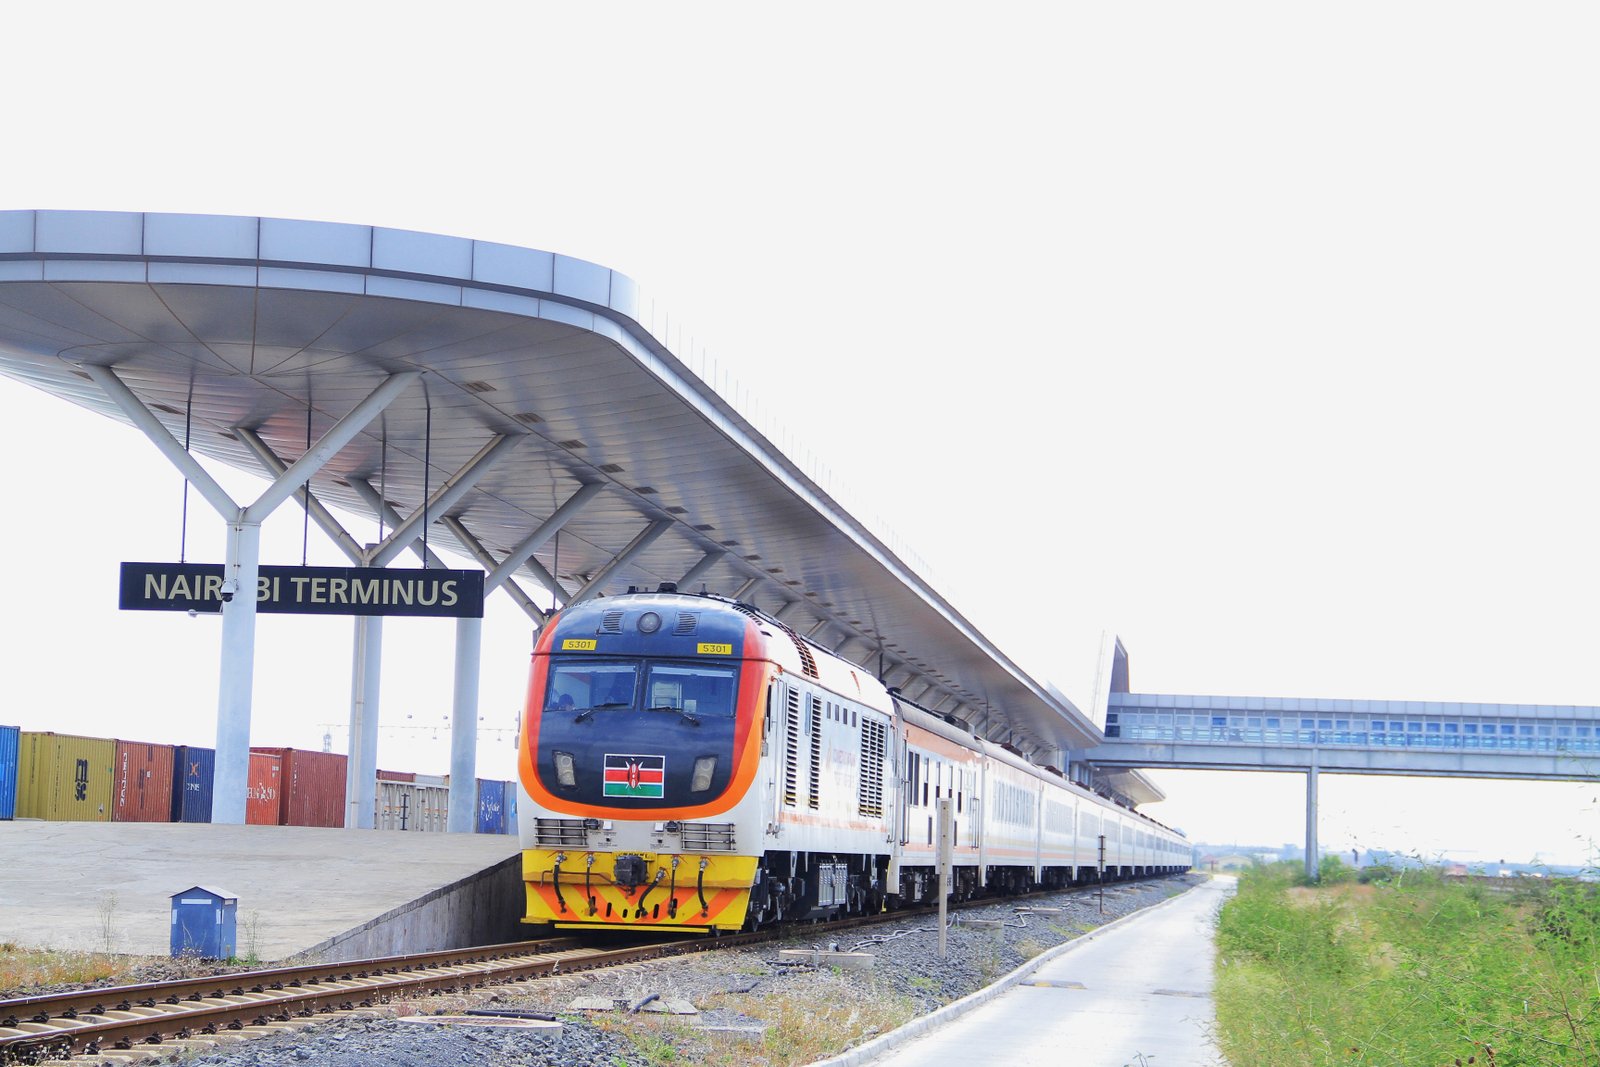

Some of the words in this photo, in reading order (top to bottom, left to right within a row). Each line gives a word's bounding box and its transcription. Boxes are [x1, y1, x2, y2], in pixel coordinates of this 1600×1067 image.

[144, 573, 279, 602] NAIRBI
[290, 576, 458, 607] TERMINUS
[568, 640, 591, 649] 5301
[703, 644, 726, 653] 5301
